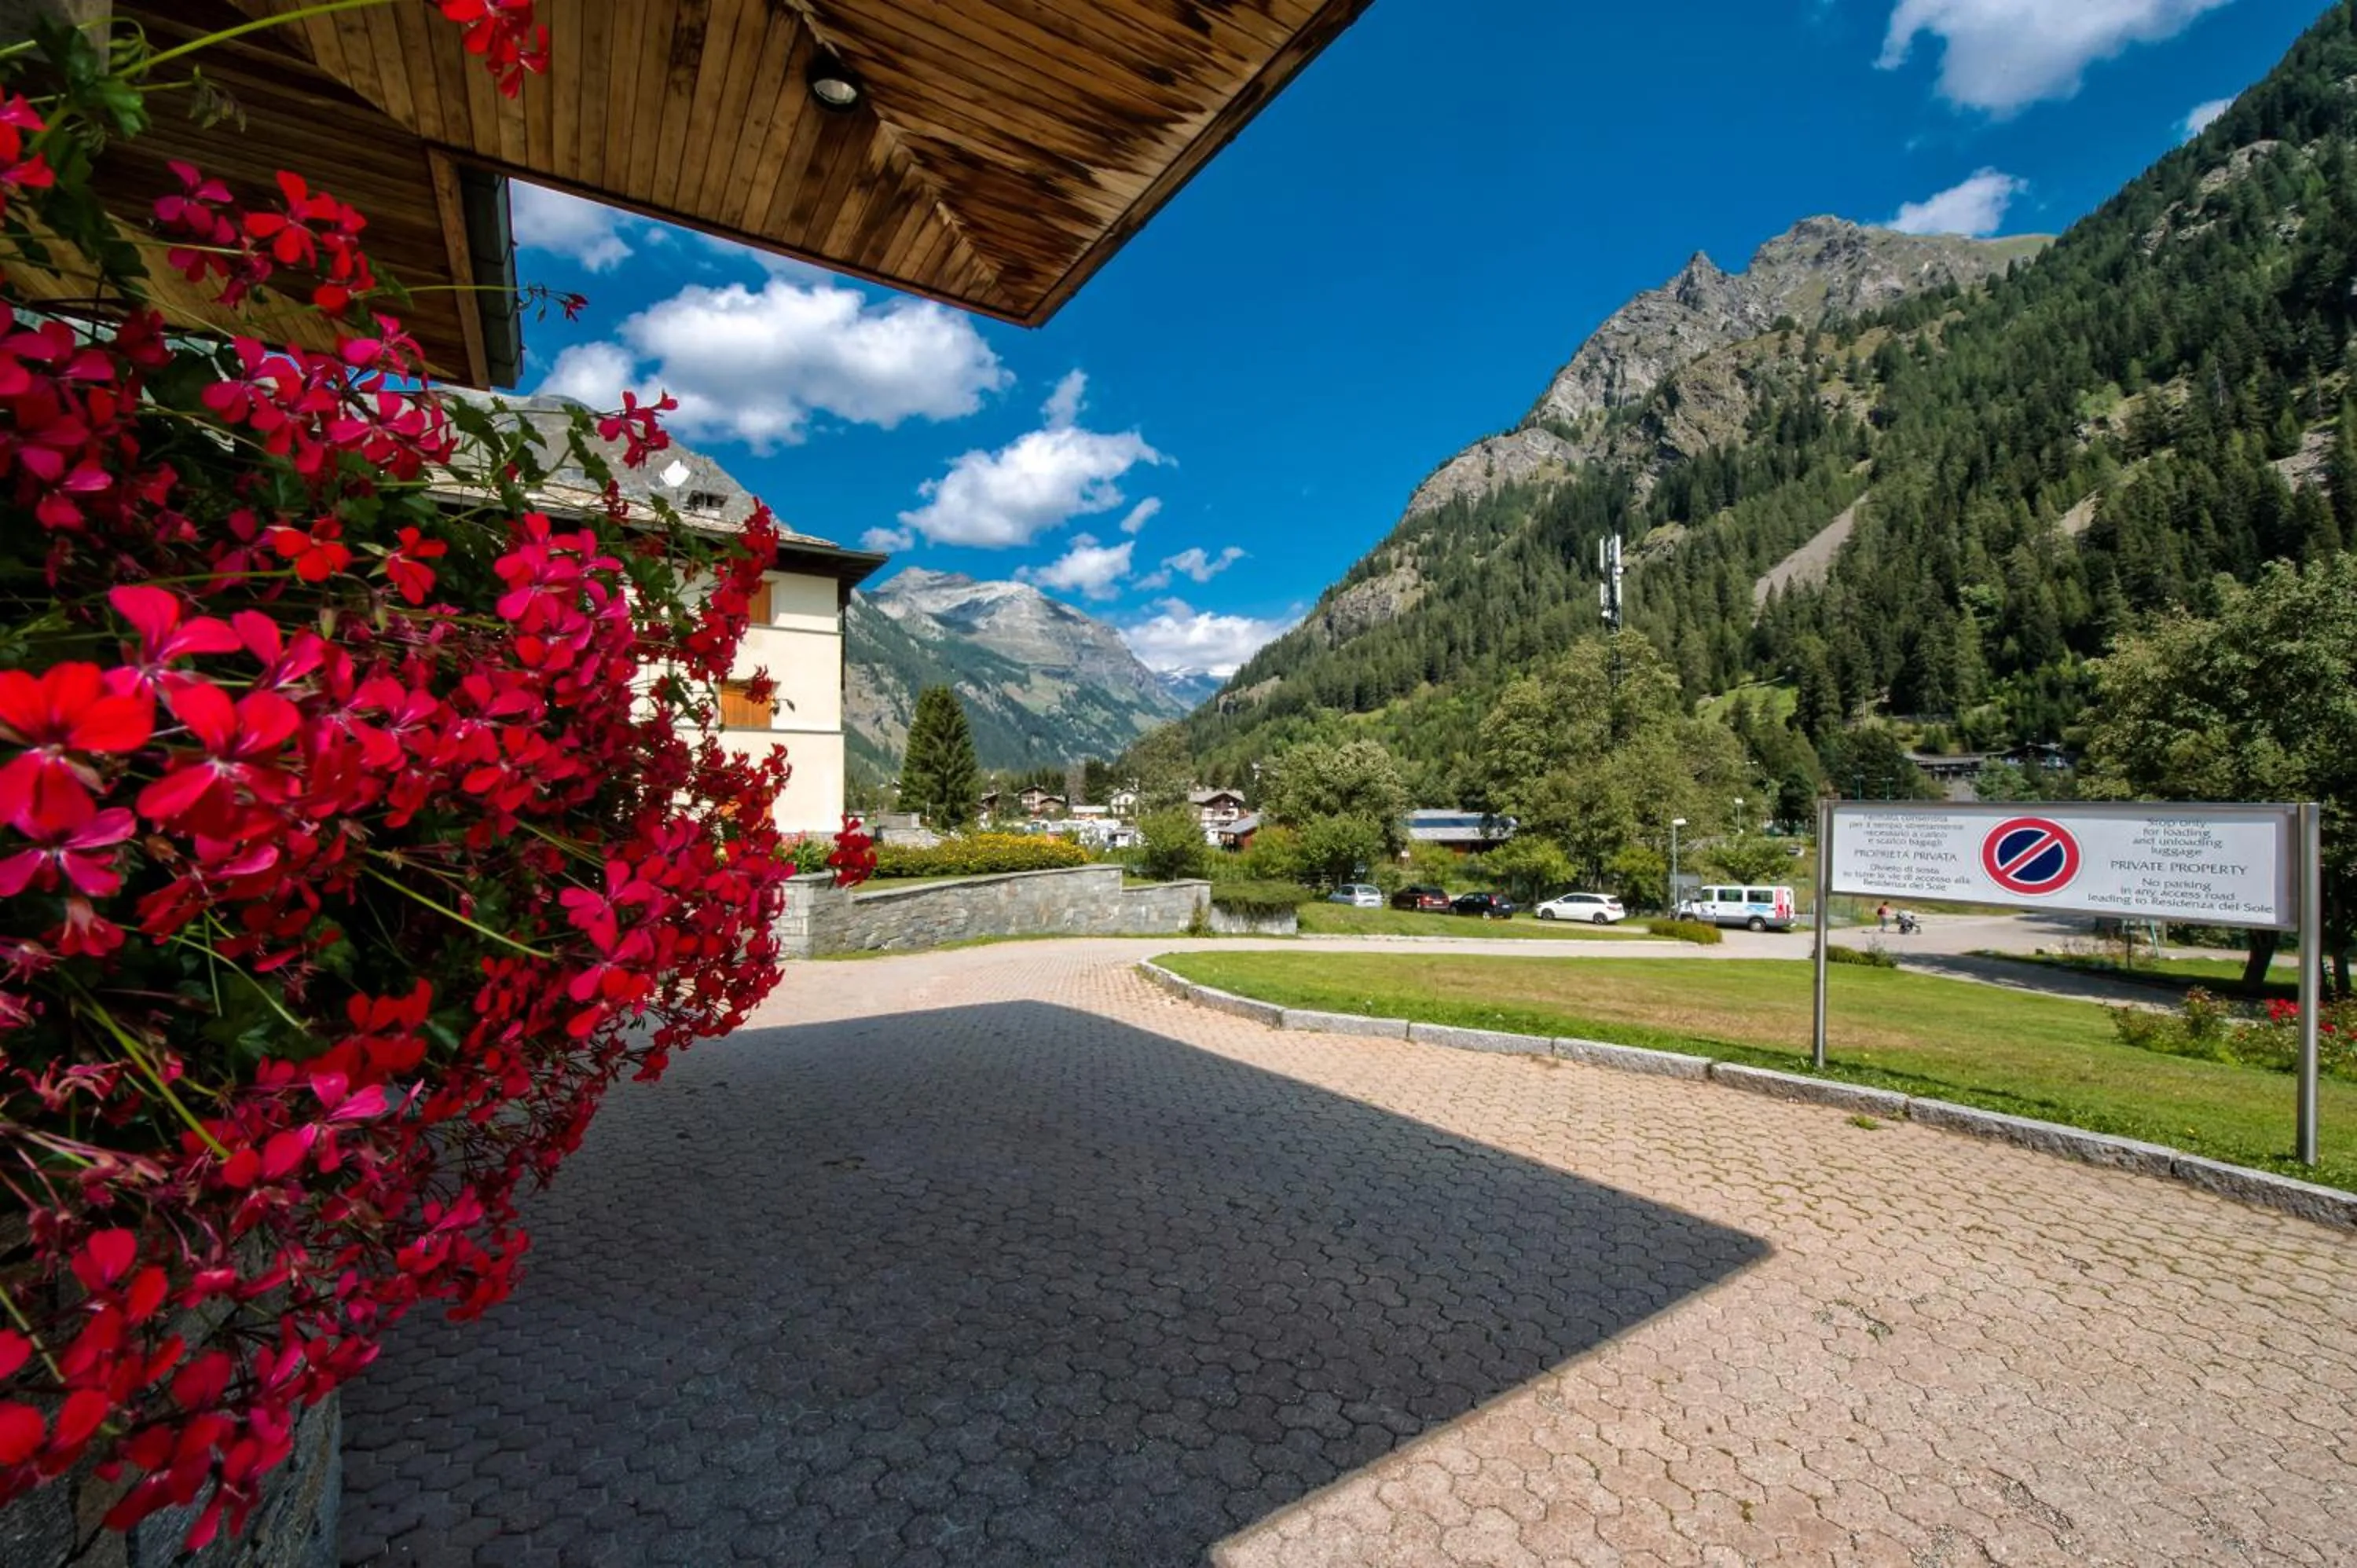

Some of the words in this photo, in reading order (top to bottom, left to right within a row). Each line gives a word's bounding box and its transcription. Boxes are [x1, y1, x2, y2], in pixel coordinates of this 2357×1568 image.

[2179, 819, 2207, 828] only
[2163, 828, 2212, 839] loading
[2159, 837, 2223, 848] unloading
[2151, 846, 2202, 858] luggage
[2110, 860, 2164, 871] PRIVATE
[2170, 863, 2248, 875] PROPERTY
[2142, 877, 2160, 886] No
[2164, 879, 2212, 892] parking
[2135, 888, 2156, 897] any
[2160, 890, 2201, 899] access
[2205, 892, 2236, 901] road
[2088, 893, 2131, 905] leading
[2151, 898, 2214, 910] Residenza
[2218, 901, 2238, 911] del
